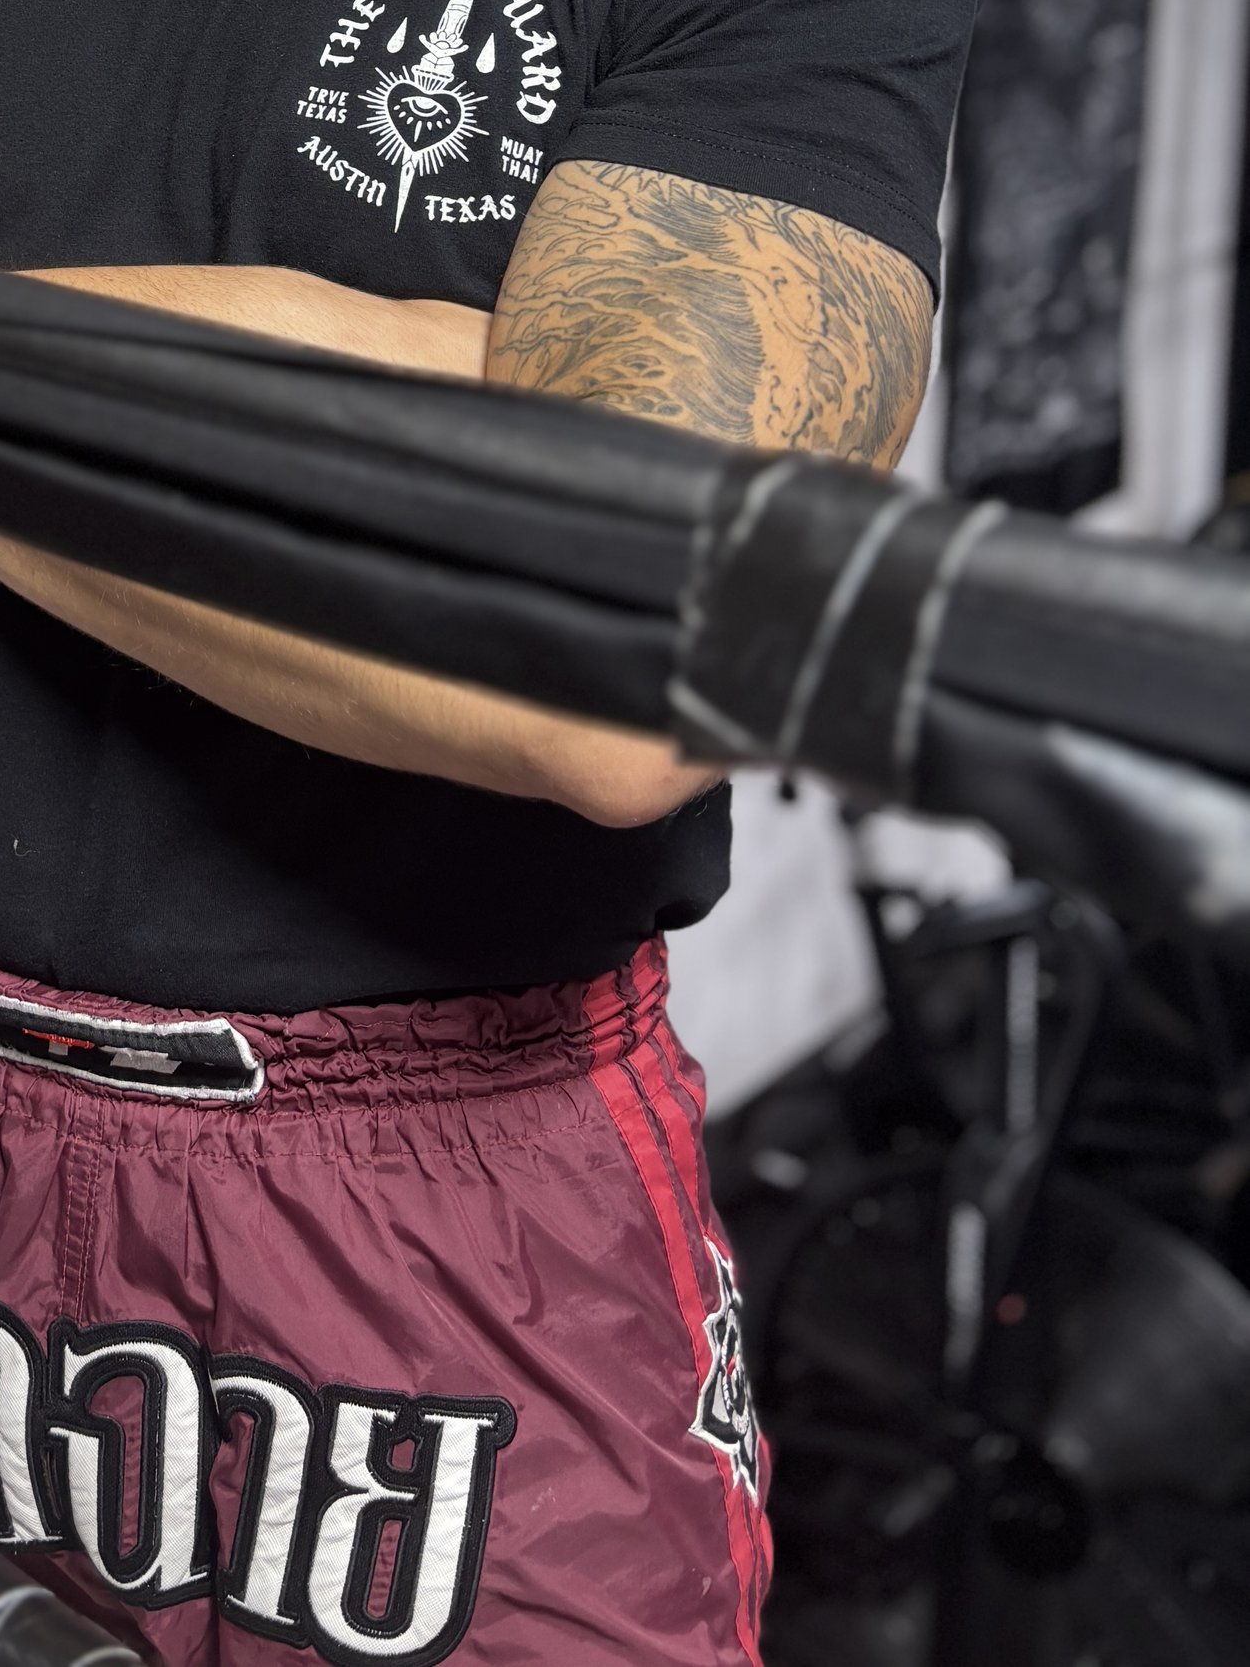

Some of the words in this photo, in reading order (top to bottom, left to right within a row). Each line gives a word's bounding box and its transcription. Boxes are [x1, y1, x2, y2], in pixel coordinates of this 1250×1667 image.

[307, 85, 350, 107] TRVE
[296, 99, 348, 124] TEXAS
[499, 135, 544, 166] MUAY
[296, 135, 387, 207] AUSTIN
[424, 194, 516, 223] TEXAS
[501, 156, 540, 185] THAI
